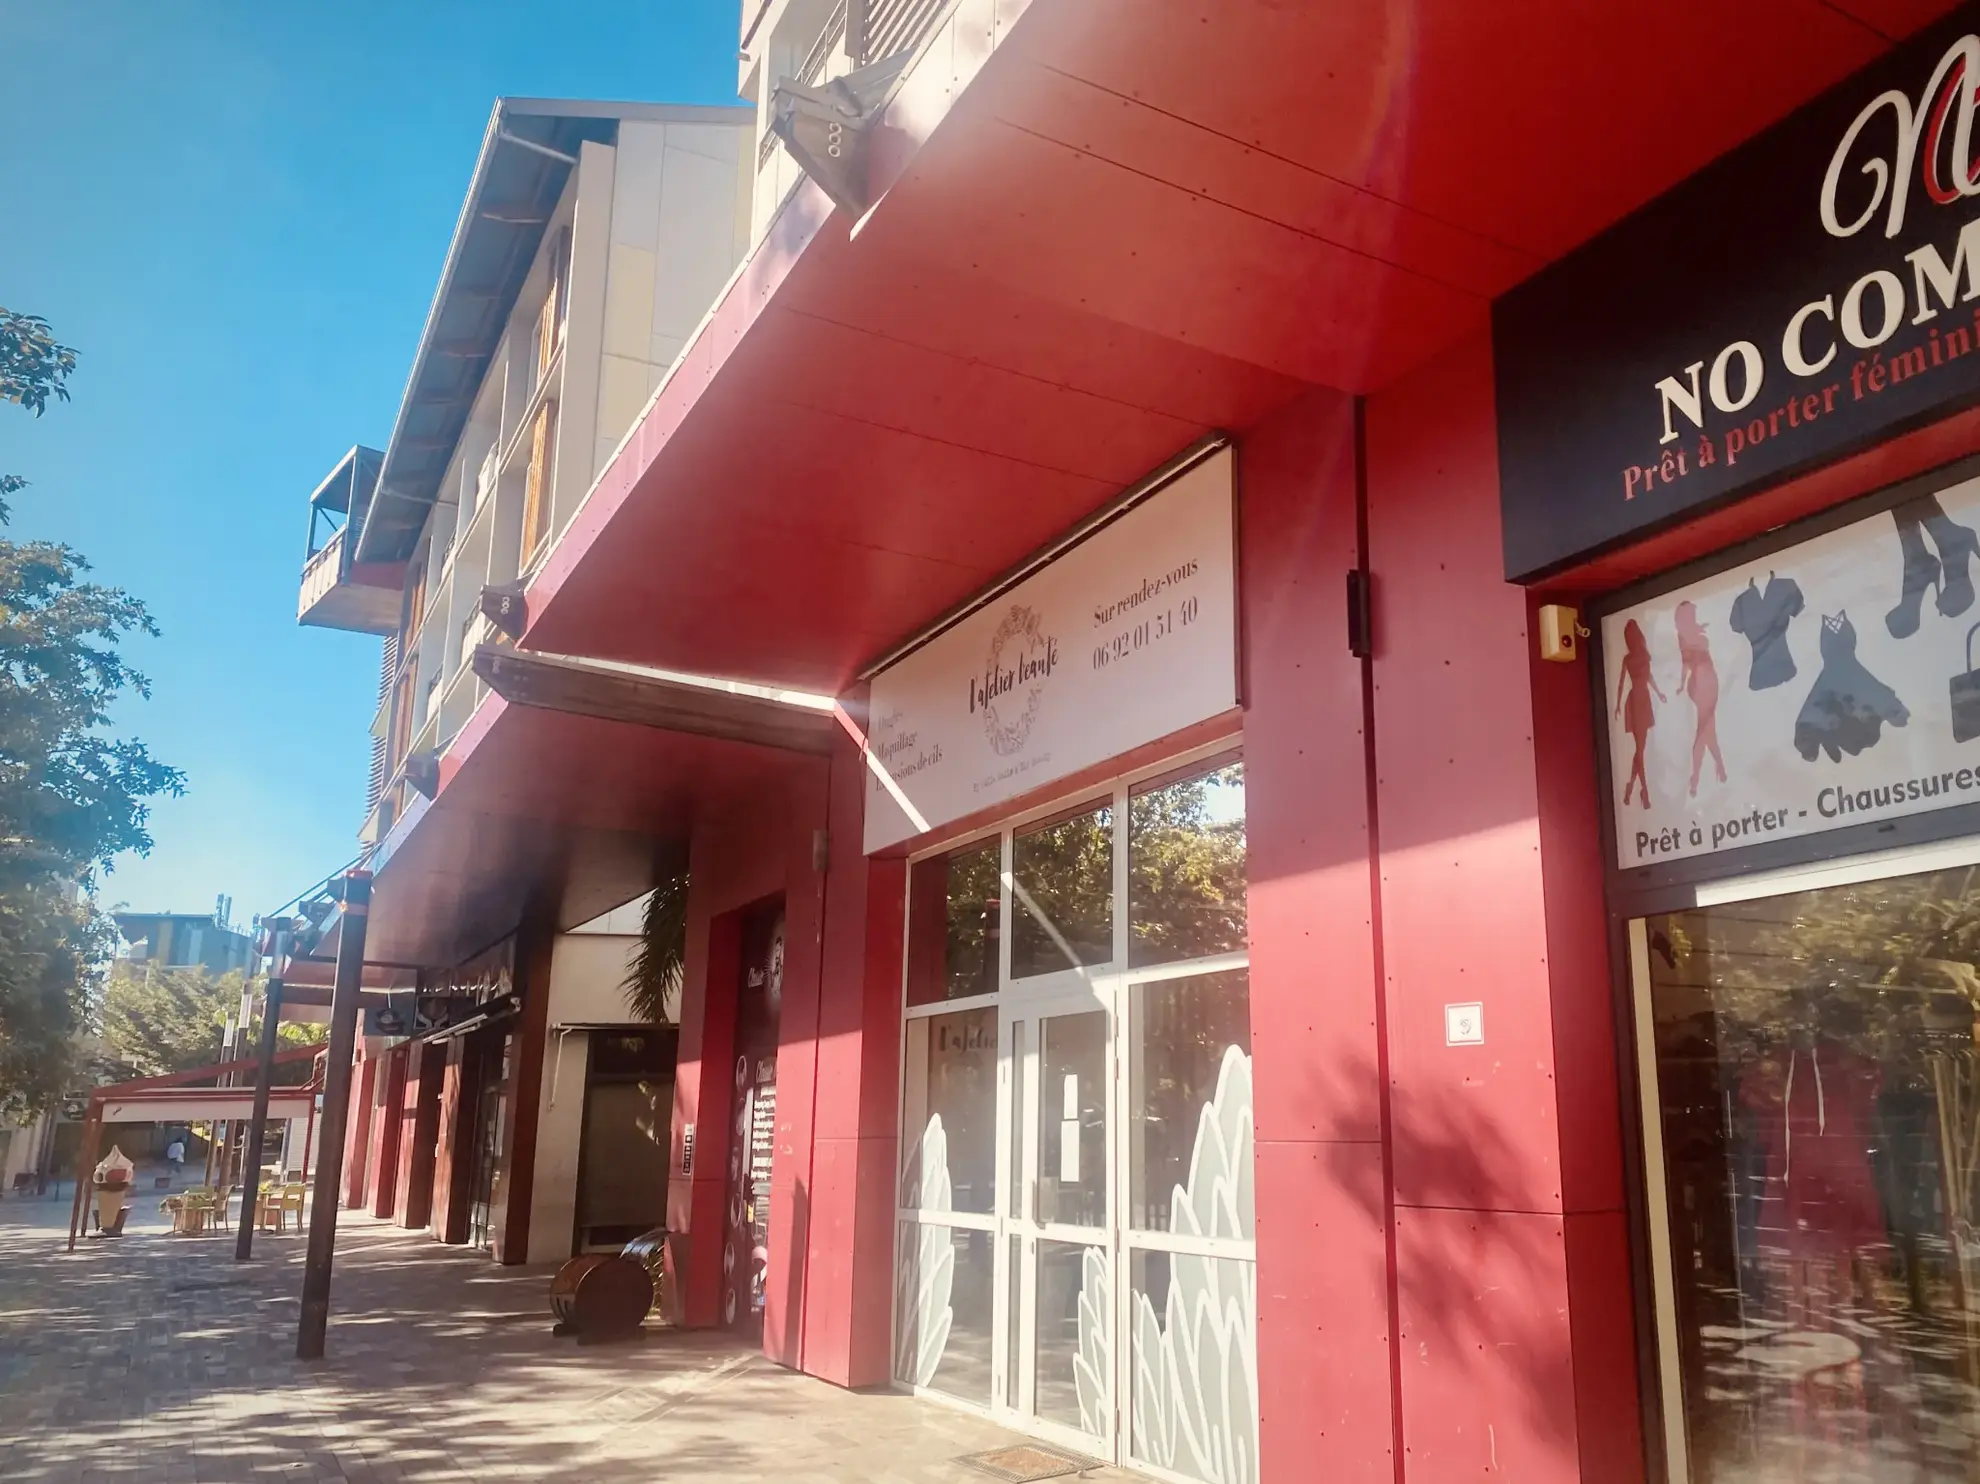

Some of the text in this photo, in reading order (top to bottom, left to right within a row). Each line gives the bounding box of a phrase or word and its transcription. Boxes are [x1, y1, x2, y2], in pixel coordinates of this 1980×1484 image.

[1654, 217, 1980, 445] NO COM
[1623, 447, 1689, 500] Prêt
[1699, 435, 1716, 467] à
[1724, 383, 1839, 466] porter
[1093, 558, 1198, 628] Sur rendez-vous
[1093, 643, 1109, 670] 06
[1113, 632, 1129, 661] 92
[1134, 621, 1149, 650] 01
[1180, 596, 1198, 626] 40
[1635, 827, 1681, 858] Prêt
[1689, 821, 1702, 846] à
[1712, 807, 1788, 848] porter
